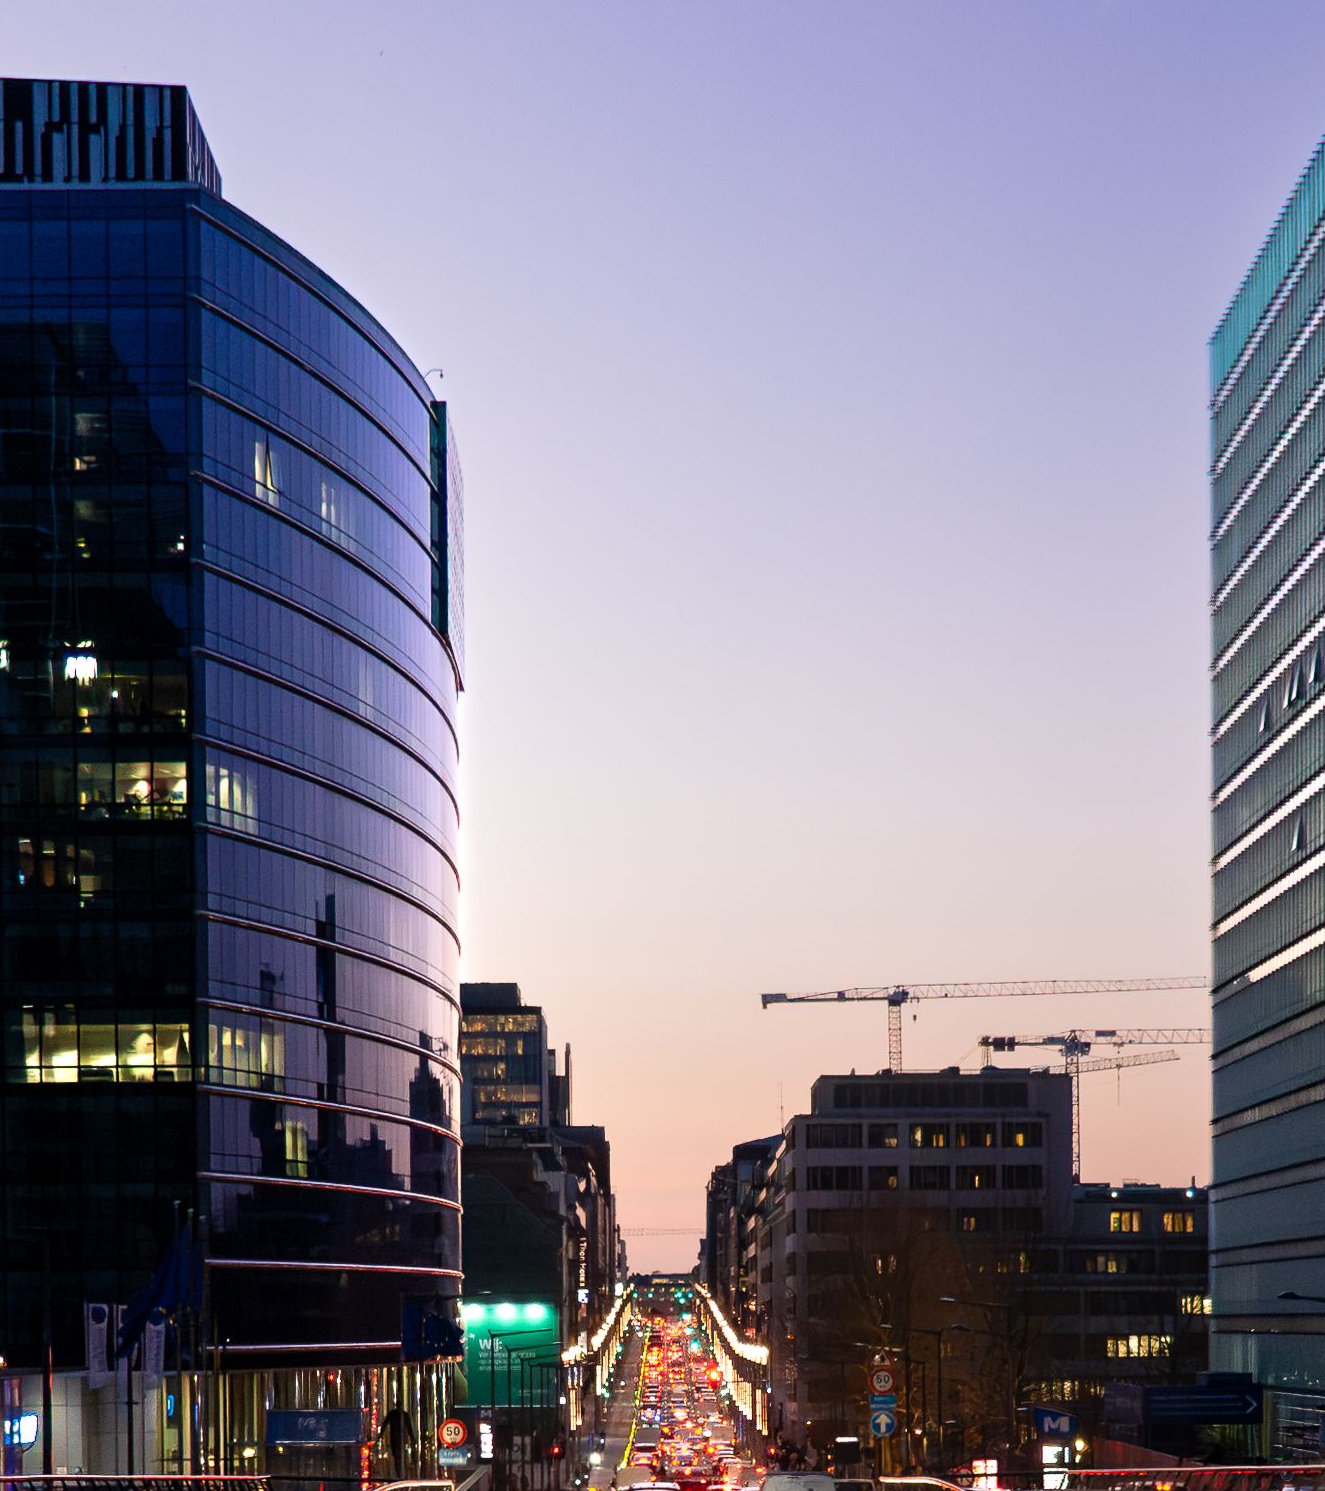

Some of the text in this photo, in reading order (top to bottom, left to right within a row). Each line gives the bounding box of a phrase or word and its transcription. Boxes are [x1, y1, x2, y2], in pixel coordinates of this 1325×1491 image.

[876, 1374, 891, 1385] 50
[1043, 1416, 1069, 1433] M
[446, 1426, 461, 1436] 50
